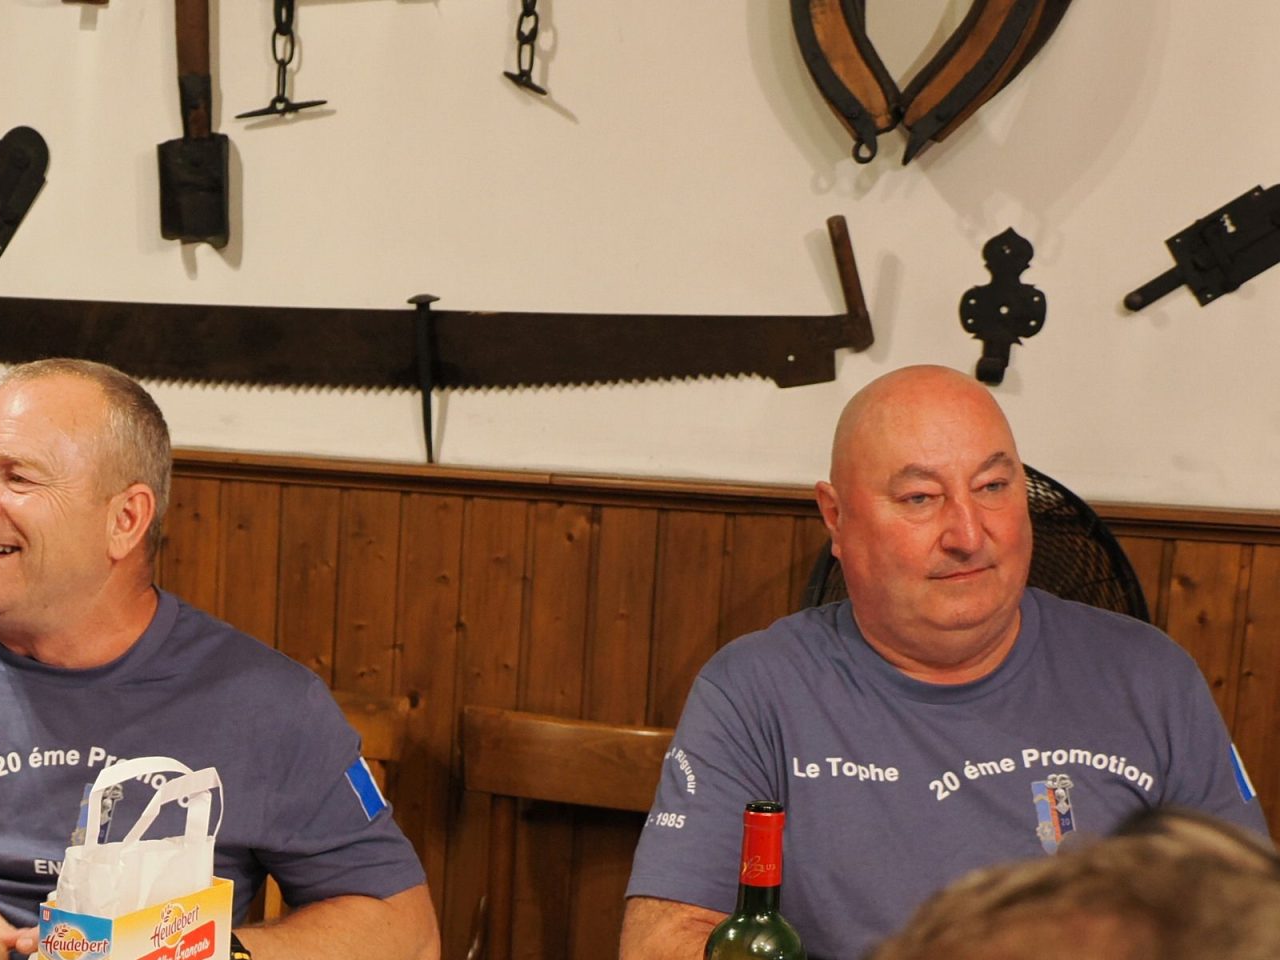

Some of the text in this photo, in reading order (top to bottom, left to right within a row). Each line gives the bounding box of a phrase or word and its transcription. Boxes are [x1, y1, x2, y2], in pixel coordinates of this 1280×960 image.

[28, 747, 80, 768] éme
[792, 757, 899, 782] Le Tophe
[674, 749, 697, 795] Rigueur
[928, 748, 1155, 801] 20 éme Promotion
[655, 812, 687, 829] 1985
[150, 905, 200, 948] Heudebert
[41, 935, 109, 955] Heudebert
